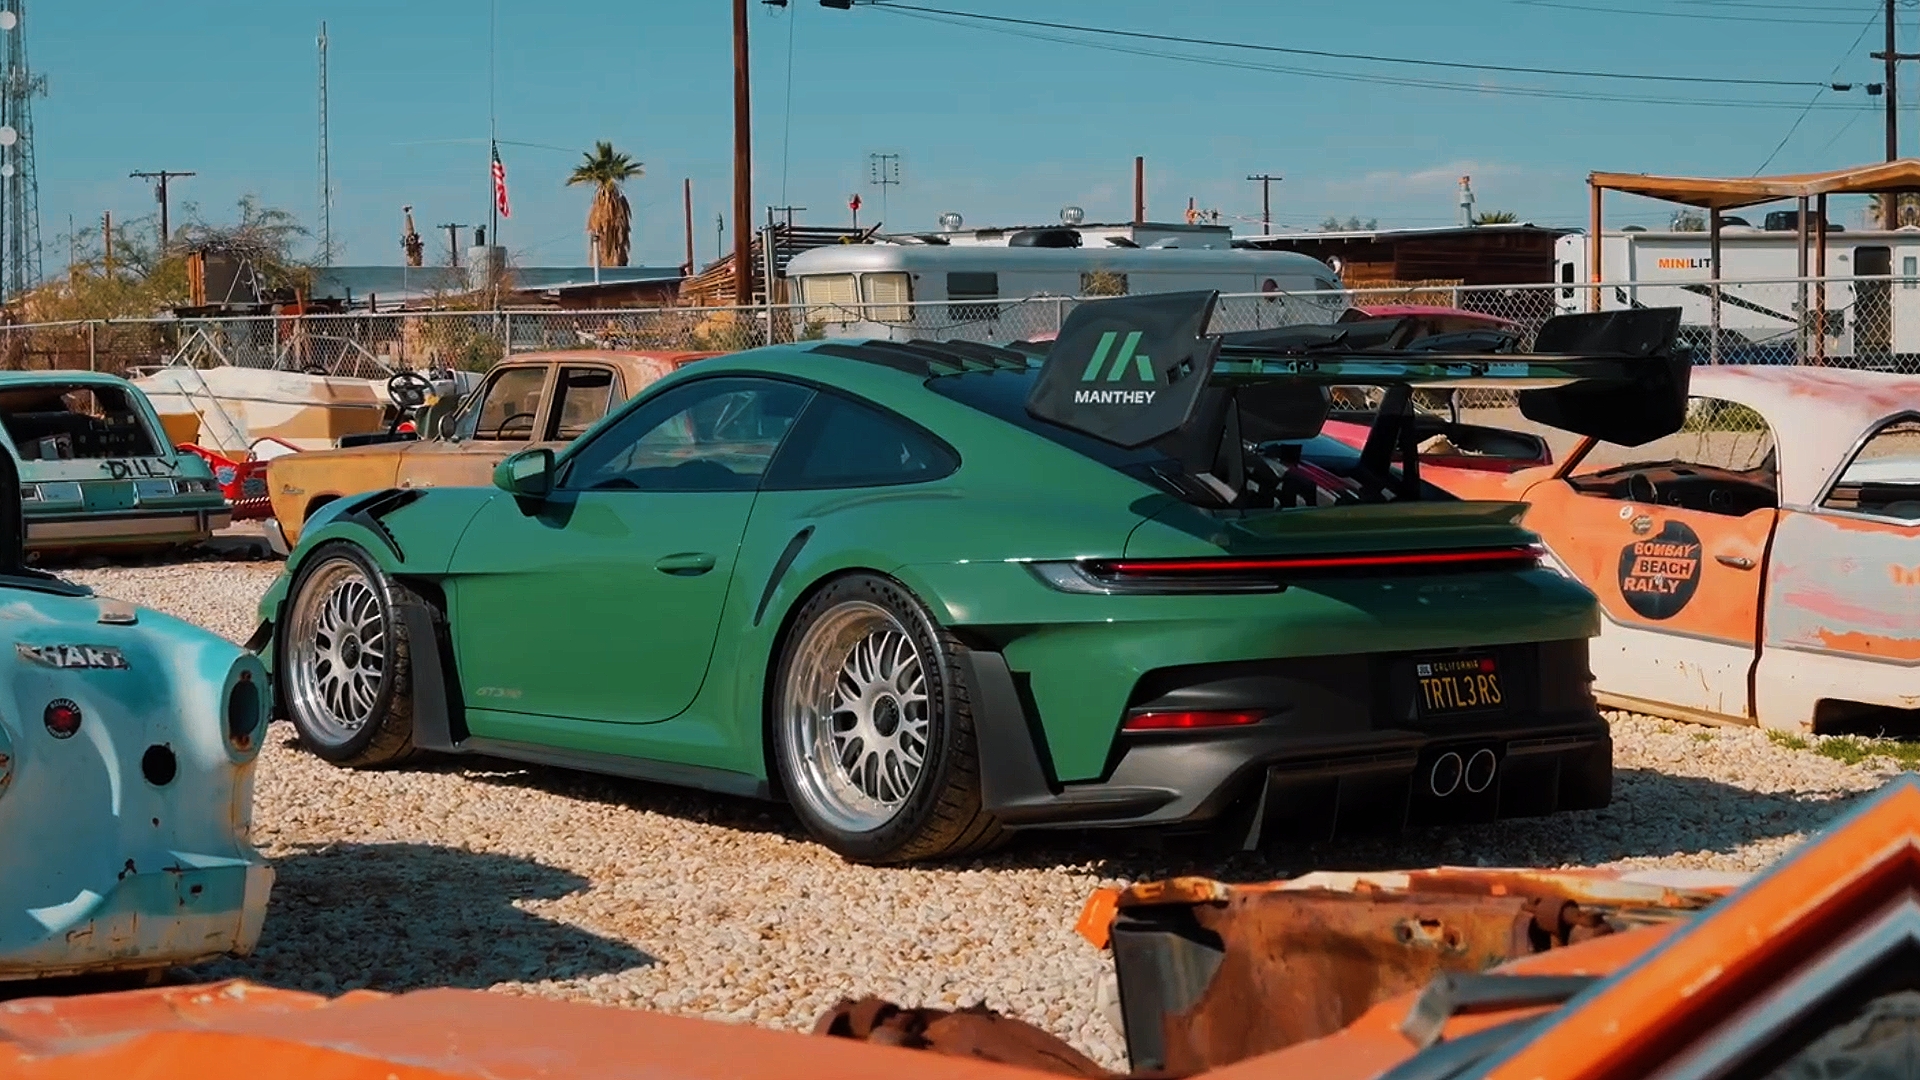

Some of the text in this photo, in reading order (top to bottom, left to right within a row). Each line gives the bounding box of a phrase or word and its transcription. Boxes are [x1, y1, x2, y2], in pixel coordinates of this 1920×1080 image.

[1658, 258, 1721, 268] MINILIT
[1074, 390, 1156, 404] MANTHEY
[1634, 542, 1699, 557] BOMBAY
[1639, 560, 1691, 575] BEACH
[1623, 577, 1680, 594] RALLY
[1433, 660, 1479, 672] CALIFORNIA
[1420, 674, 1501, 709] TRTL3RS
